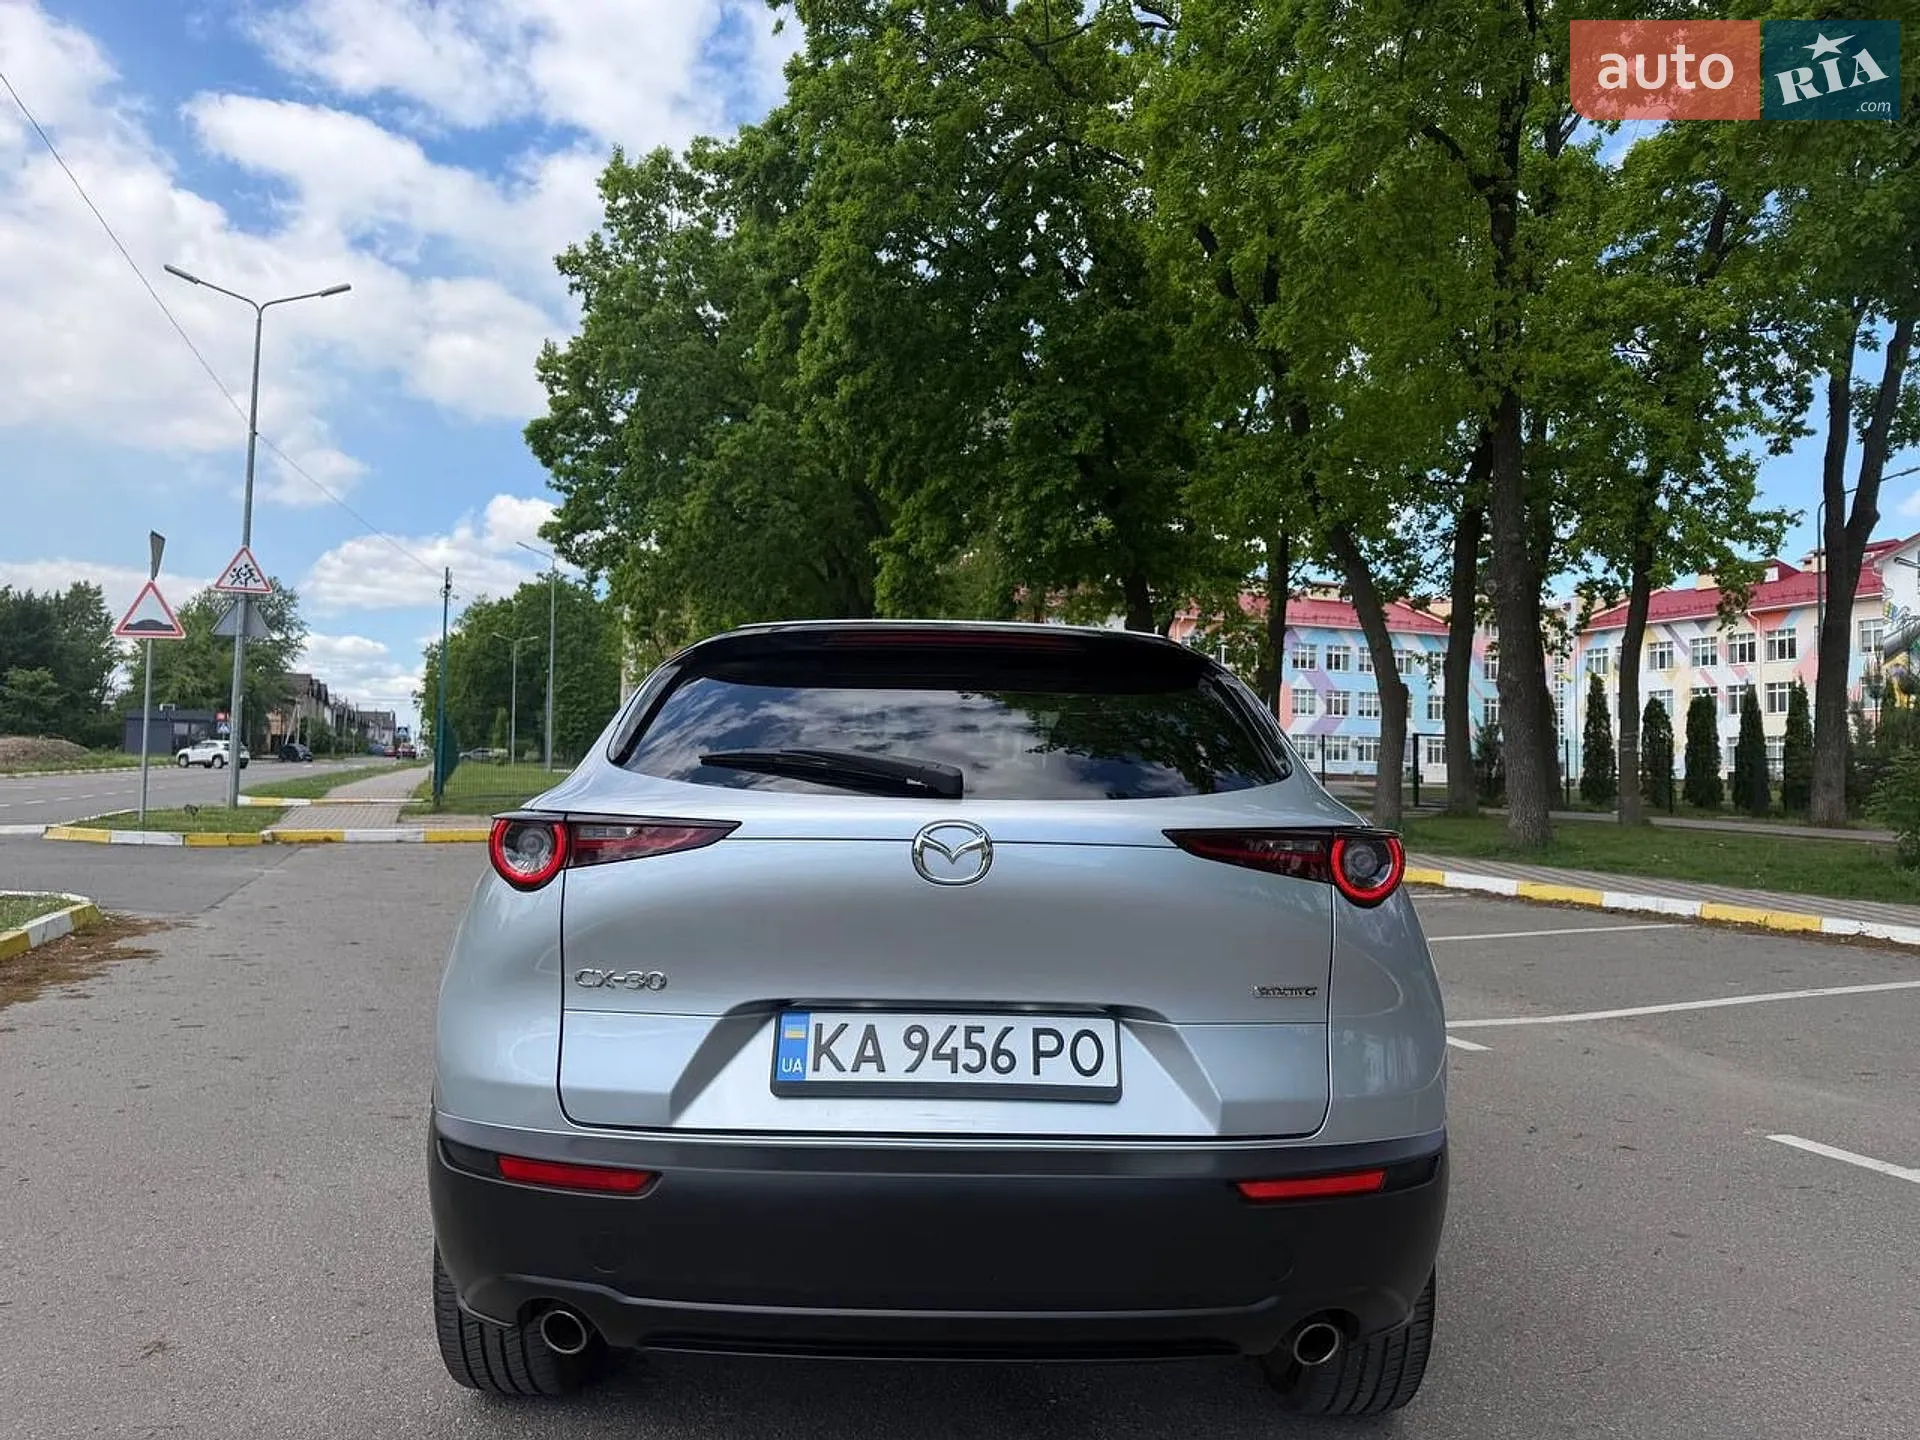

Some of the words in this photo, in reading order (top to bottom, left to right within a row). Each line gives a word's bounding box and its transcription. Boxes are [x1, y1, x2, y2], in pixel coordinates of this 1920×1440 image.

[575, 968, 667, 991] CX-30
[812, 1023, 886, 1073] KA
[902, 1024, 1017, 1075] 9456
[1032, 1027, 1105, 1077] PO
[782, 1057, 803, 1073] UA
